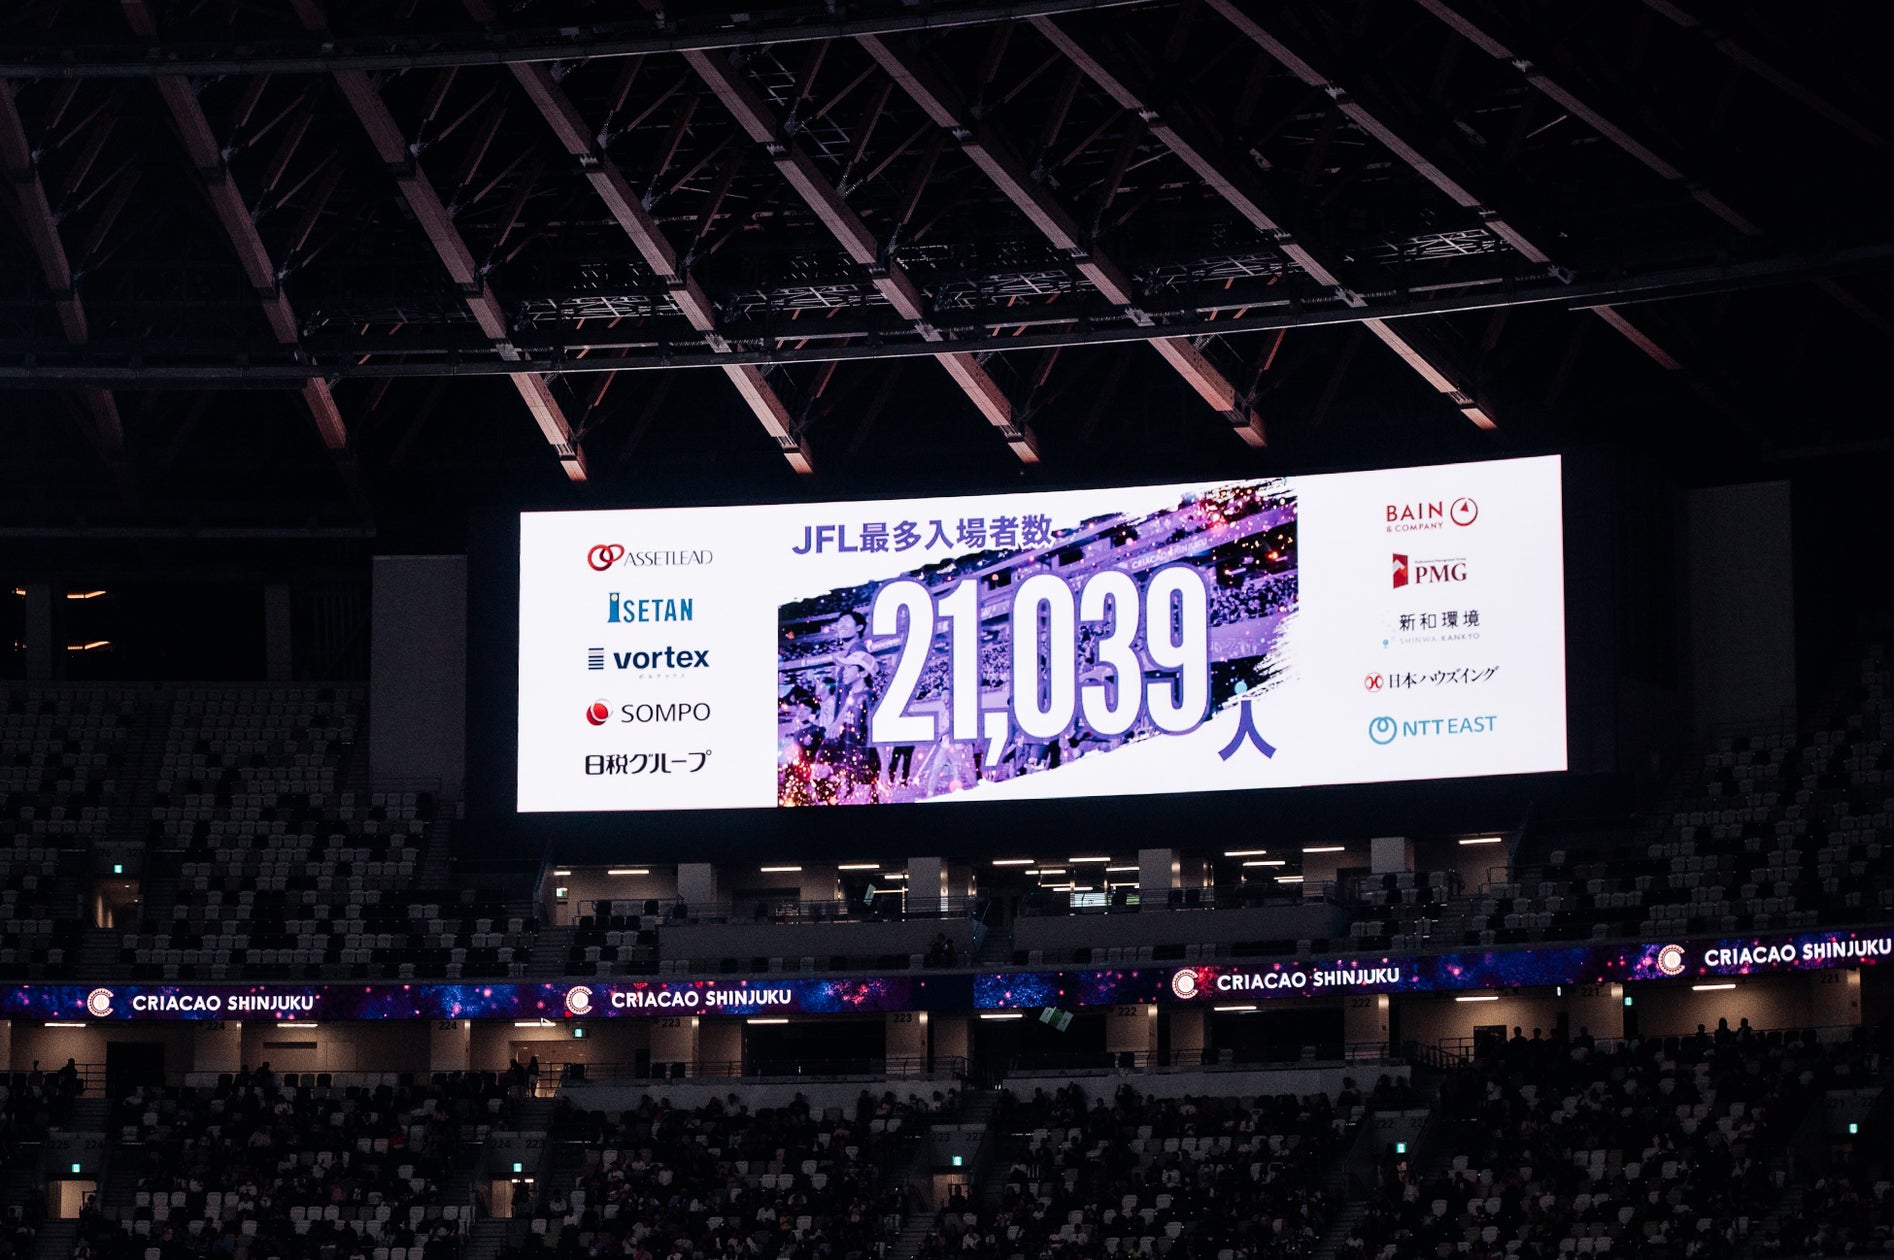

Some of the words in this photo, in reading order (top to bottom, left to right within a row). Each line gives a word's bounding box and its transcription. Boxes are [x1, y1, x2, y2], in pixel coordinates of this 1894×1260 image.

[1386, 500, 1444, 523] BAIN
[791, 513, 1054, 556] JFL最多入場者数
[1395, 521, 1443, 533] COMPANY
[622, 549, 713, 568] ASSETLEAD
[1414, 562, 1468, 585] PMG
[607, 591, 694, 624] ISETAN
[1398, 608, 1481, 632] 新和環境
[1441, 632, 1480, 642] KANKYO
[613, 646, 710, 670] vortex
[869, 565, 1210, 769] 21,039
[1217, 698, 1278, 762] 人
[1388, 665, 1500, 690] 日本ハウズイング
[620, 702, 712, 724] SOMPO
[1403, 719, 1444, 738] NTT
[1447, 715, 1498, 735] EAST
[584, 748, 713, 776] 日税グループ
[1704, 944, 1796, 967] CRIACAO
[1802, 938, 1892, 960] SHINJUKU
[1216, 971, 1307, 991] CRIACAO
[1312, 967, 1400, 987] SHINJUKU
[132, 995, 221, 1011] CRIACAO
[227, 995, 314, 1011] SHINJUKU
[611, 991, 699, 1008] CRIACAO
[705, 989, 792, 1006] SHINJUKU
[1351, 998, 1371, 1008] 222
[661, 1018, 681, 1028] 223
[893, 1013, 913, 1023] 223
[1118, 1007, 1137, 1017] 222
[206, 1021, 225, 1031] 224
[438, 1021, 457, 1031] 224
